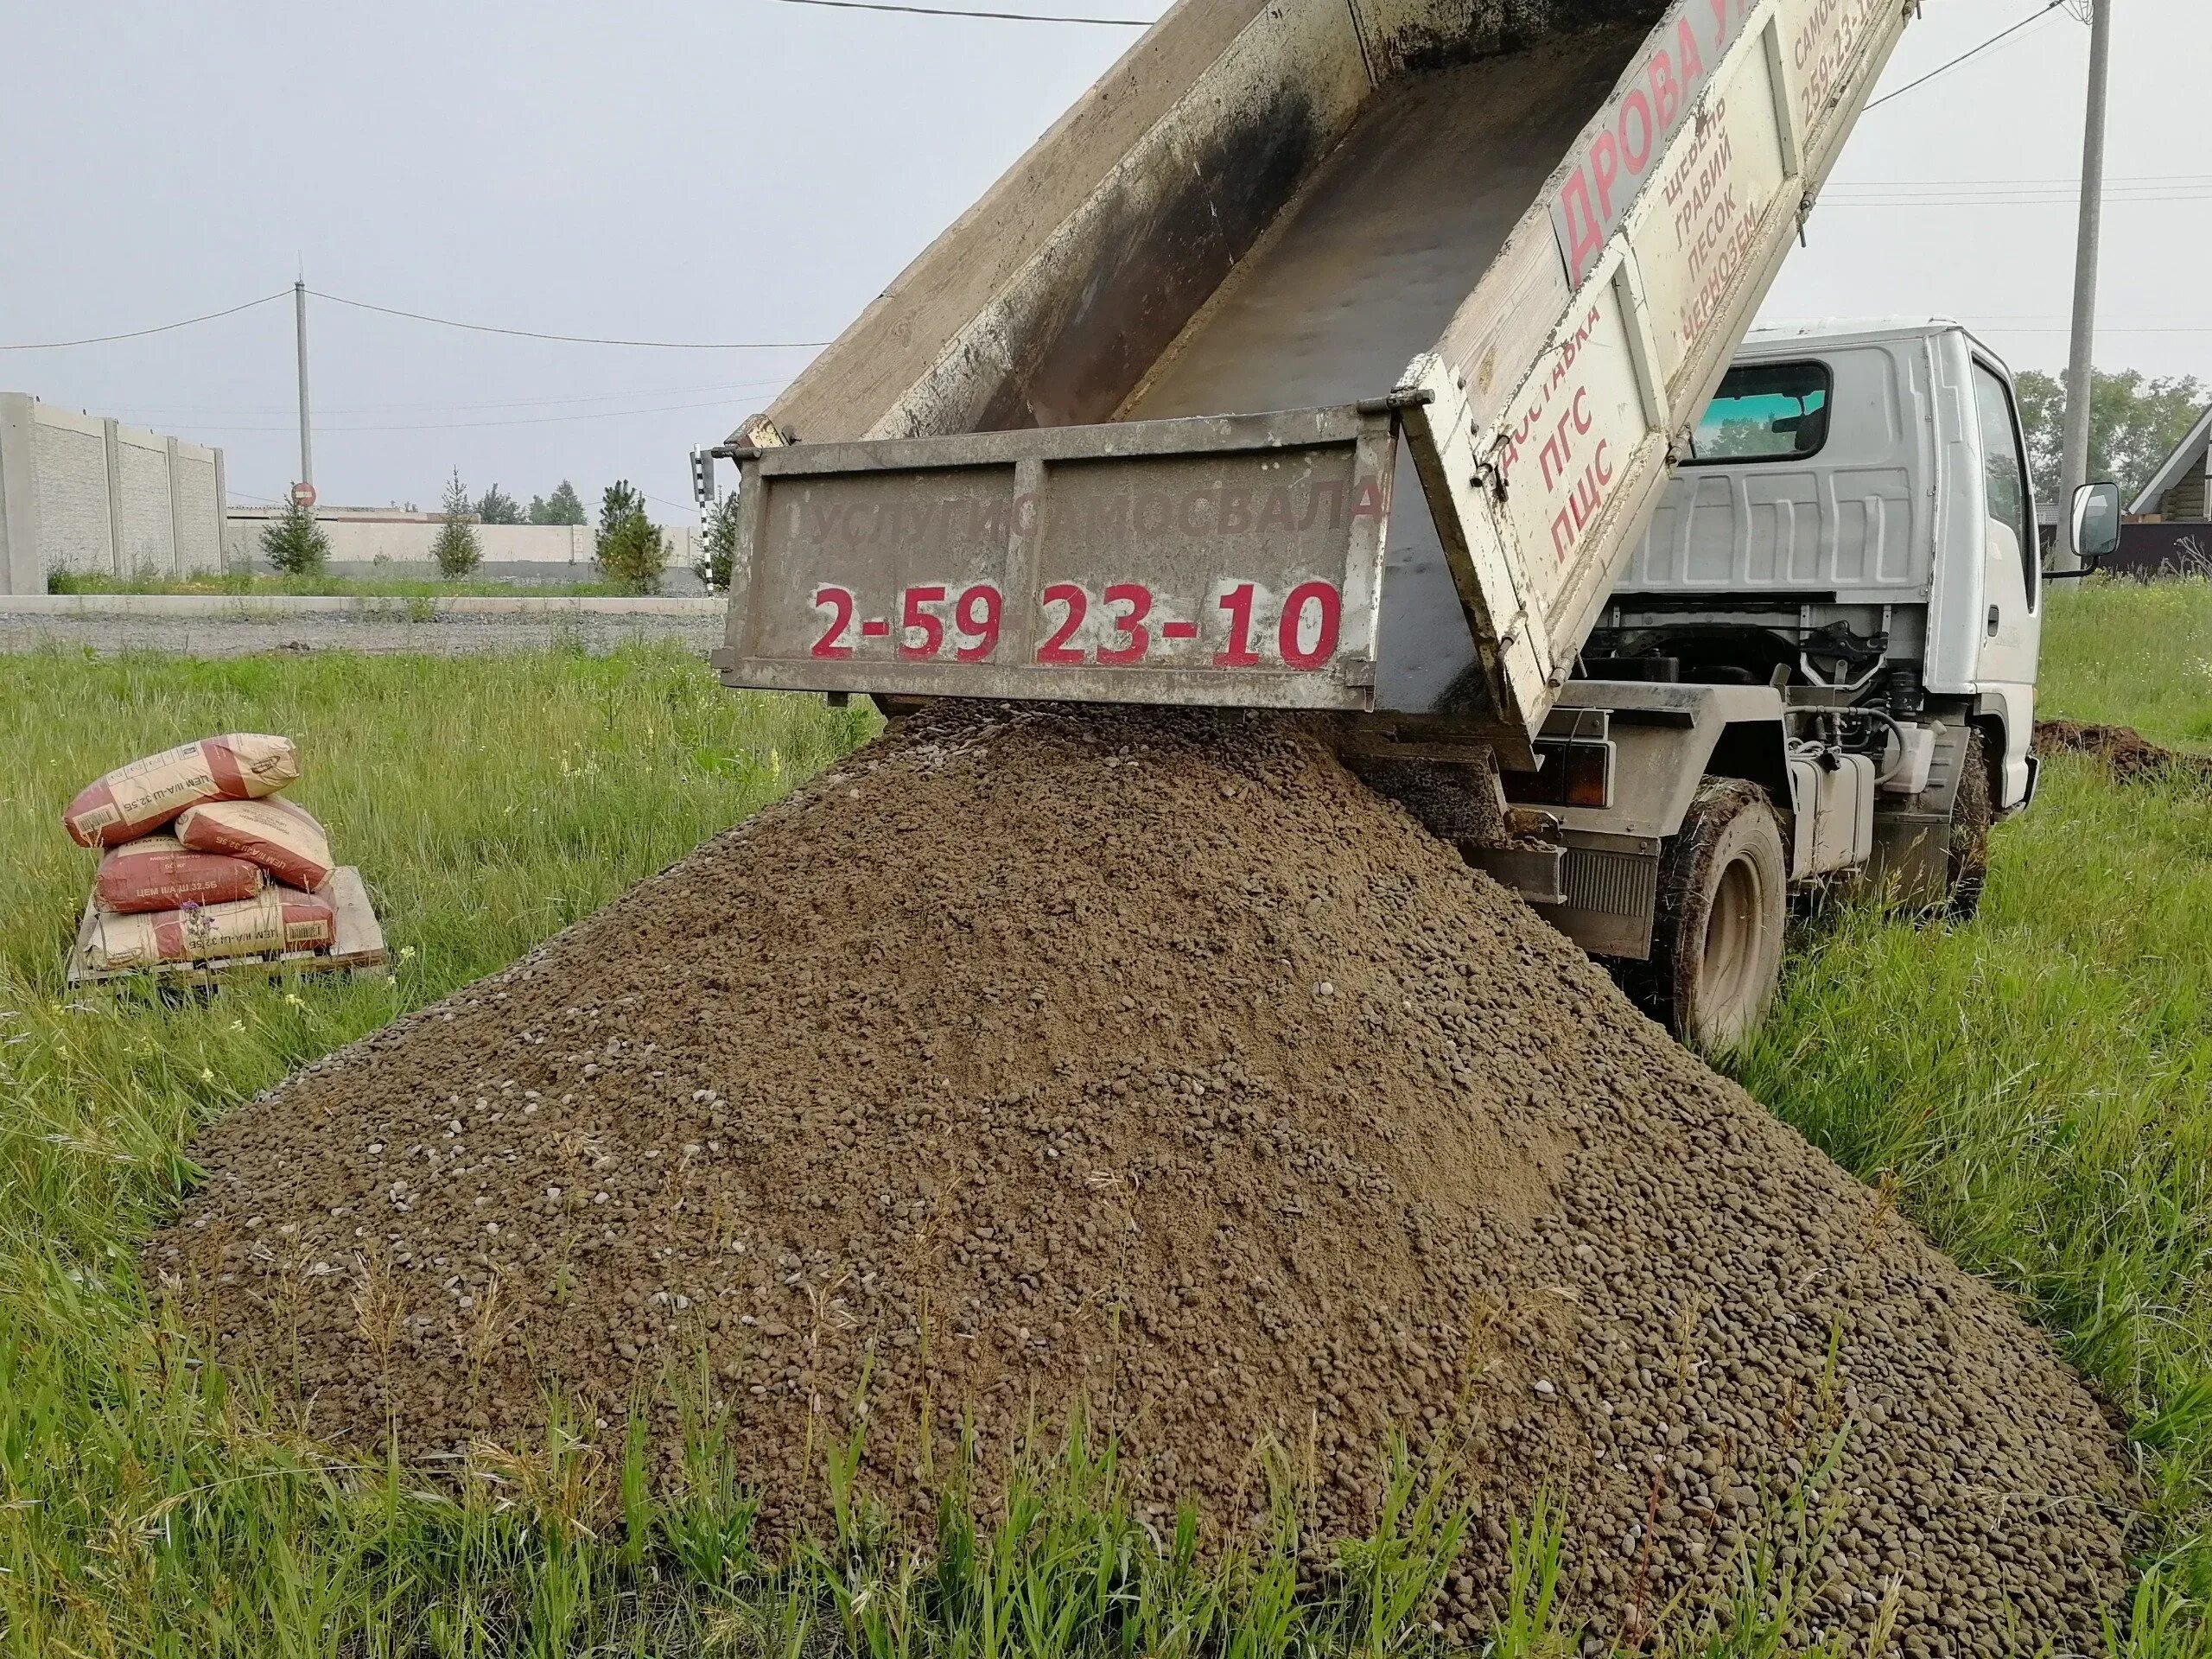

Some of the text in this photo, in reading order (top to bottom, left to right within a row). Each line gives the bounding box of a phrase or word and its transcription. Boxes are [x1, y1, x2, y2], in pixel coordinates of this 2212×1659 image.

[1561, 17, 1705, 290] ДРОВА
[1675, 126, 1732, 247] ГРАВИЙ
[1680, 201, 1758, 343] ЧЕРНОЗЕМ
[1688, 182, 1736, 283] ПЕСОК
[1539, 385, 1592, 493] ПГС
[1551, 439, 1612, 563] ПЩС
[186, 774, 210, 788] ЦЕМ
[137, 887, 158, 898] ЦЕМ
